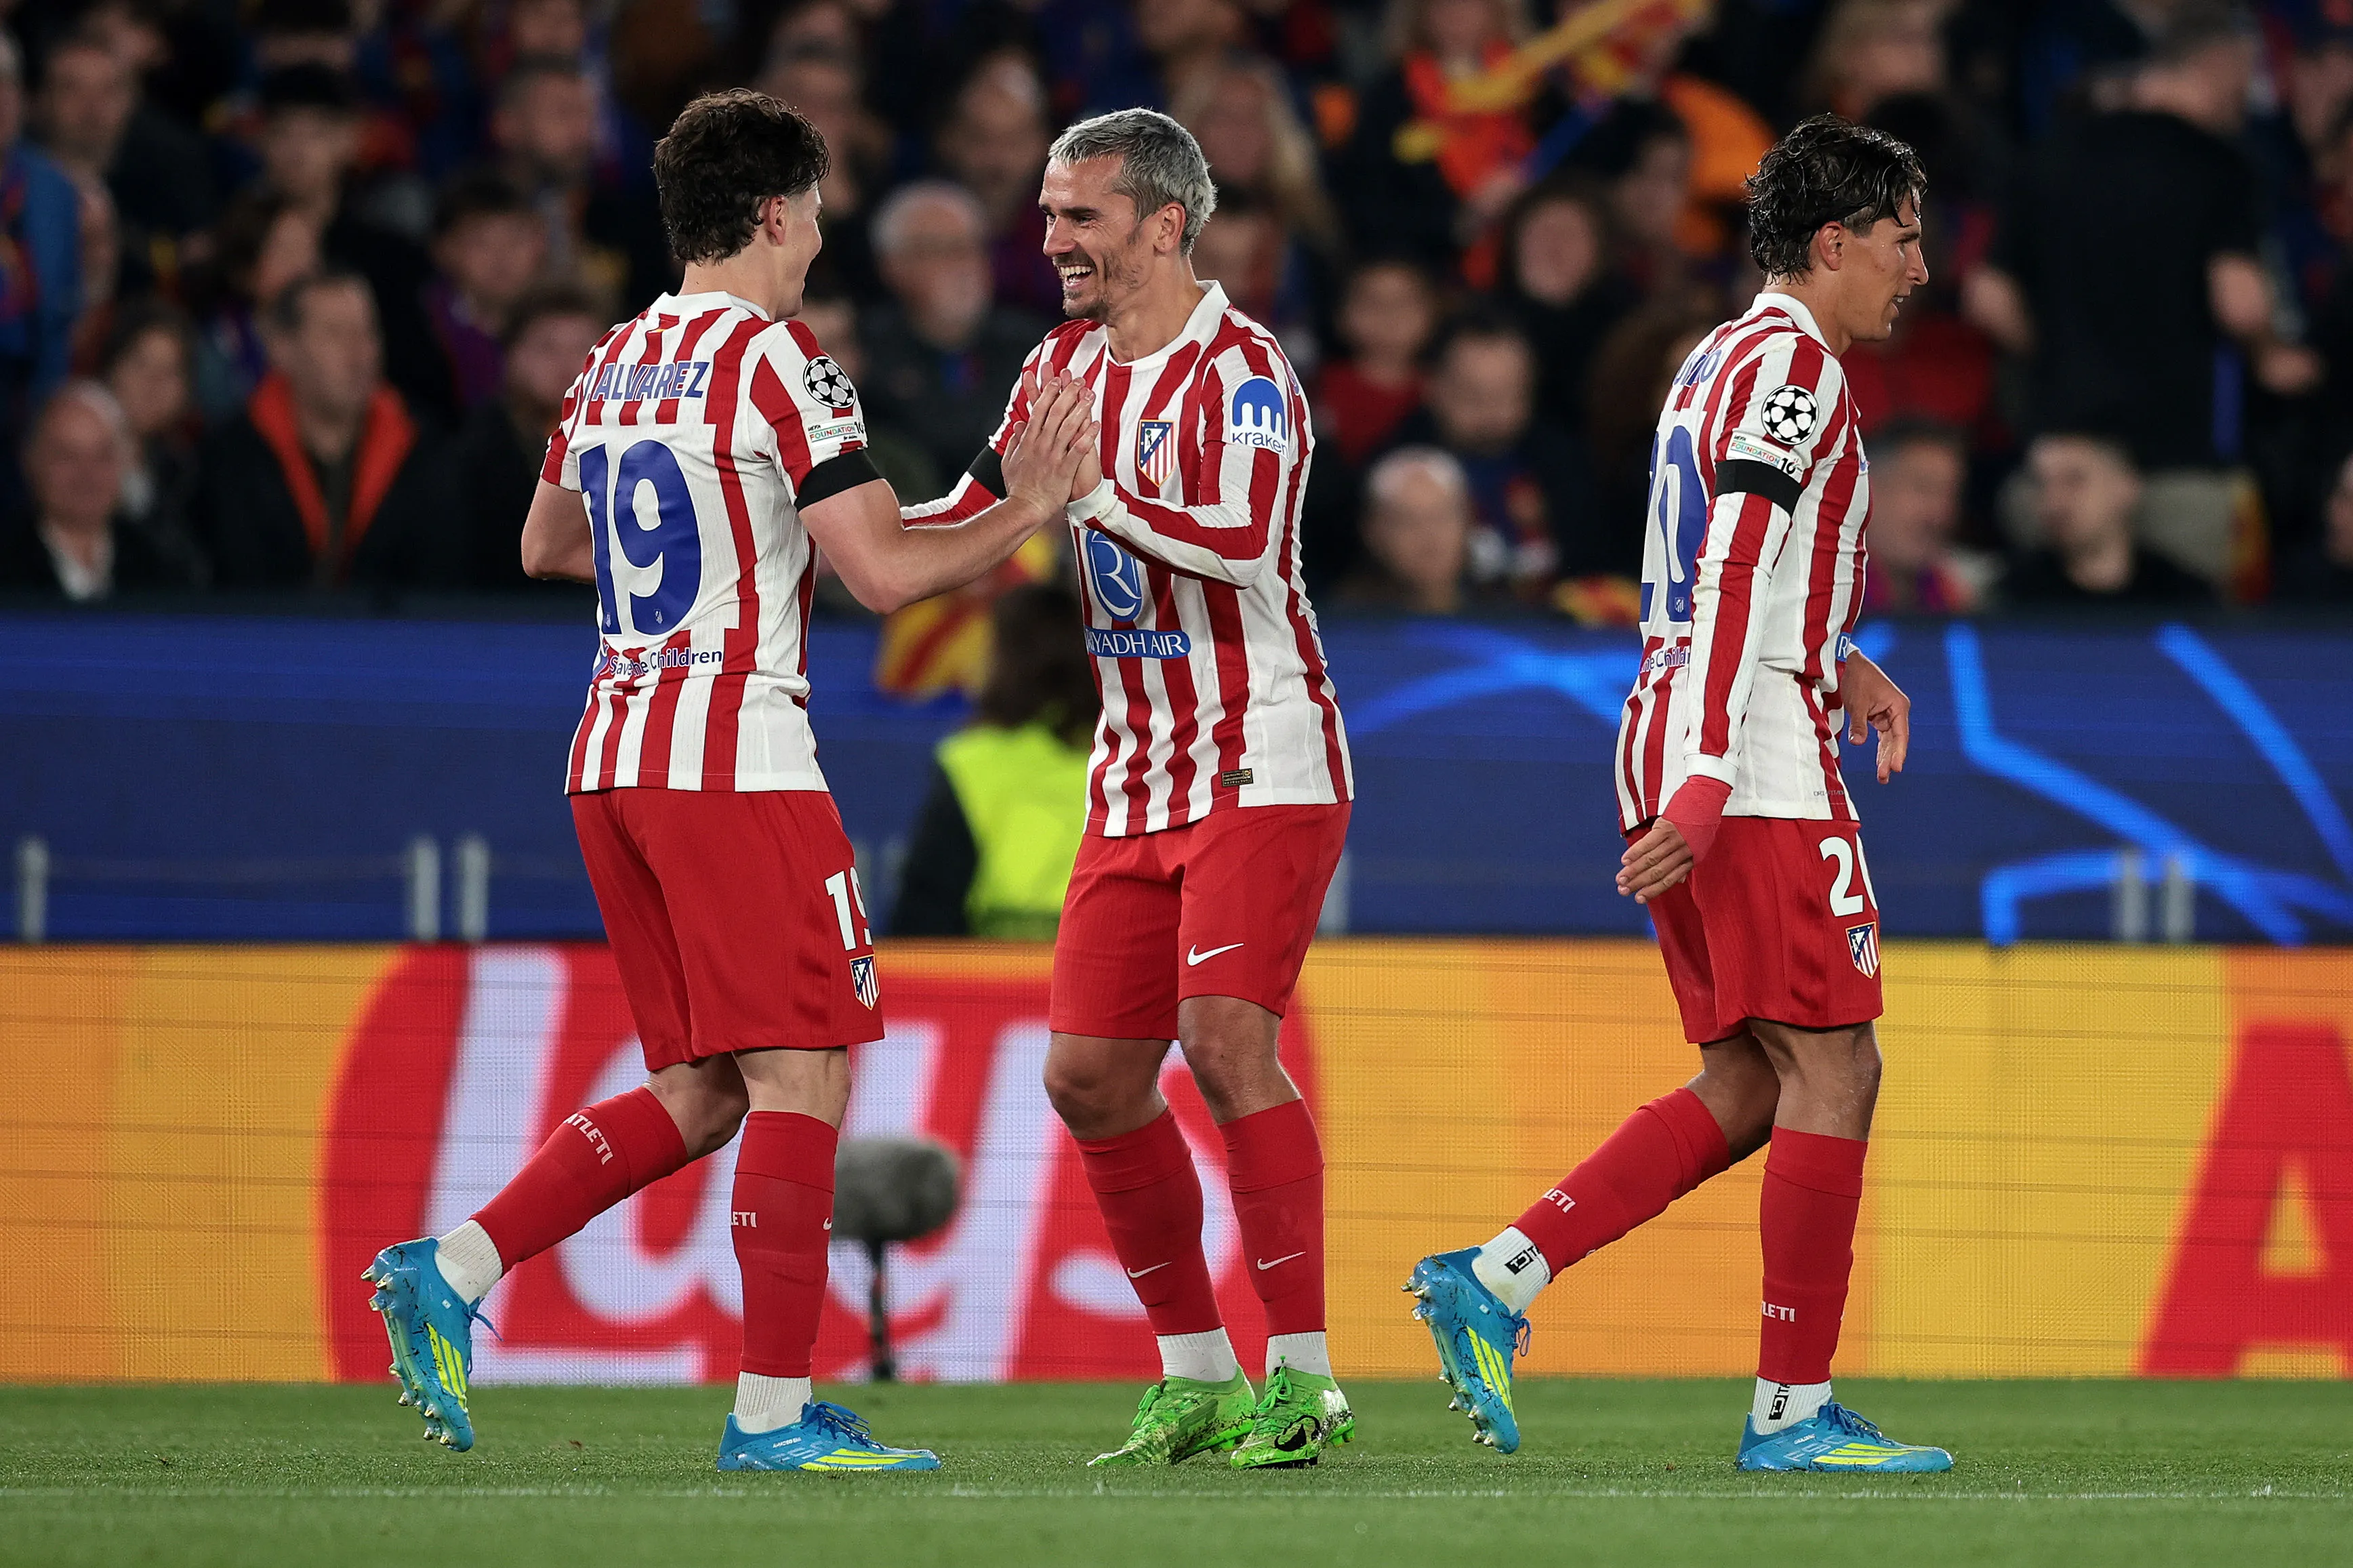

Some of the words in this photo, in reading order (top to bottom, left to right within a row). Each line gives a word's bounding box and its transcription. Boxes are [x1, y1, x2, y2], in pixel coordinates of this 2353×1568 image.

[592, 360, 710, 400] ALVAREZ
[809, 426, 856, 442] FOUNDATION
[1231, 432, 1288, 458] kraken
[1730, 442, 1781, 466] FOUNDATION
[577, 438, 703, 636] 19
[1084, 628, 1147, 655] RIYADH
[1151, 634, 1187, 656] AIR
[650, 647, 722, 671] Children
[562, 1113, 614, 1166] ATLETI
[1542, 1187, 1576, 1214] LETI
[1762, 1300, 1796, 1323] LETI
